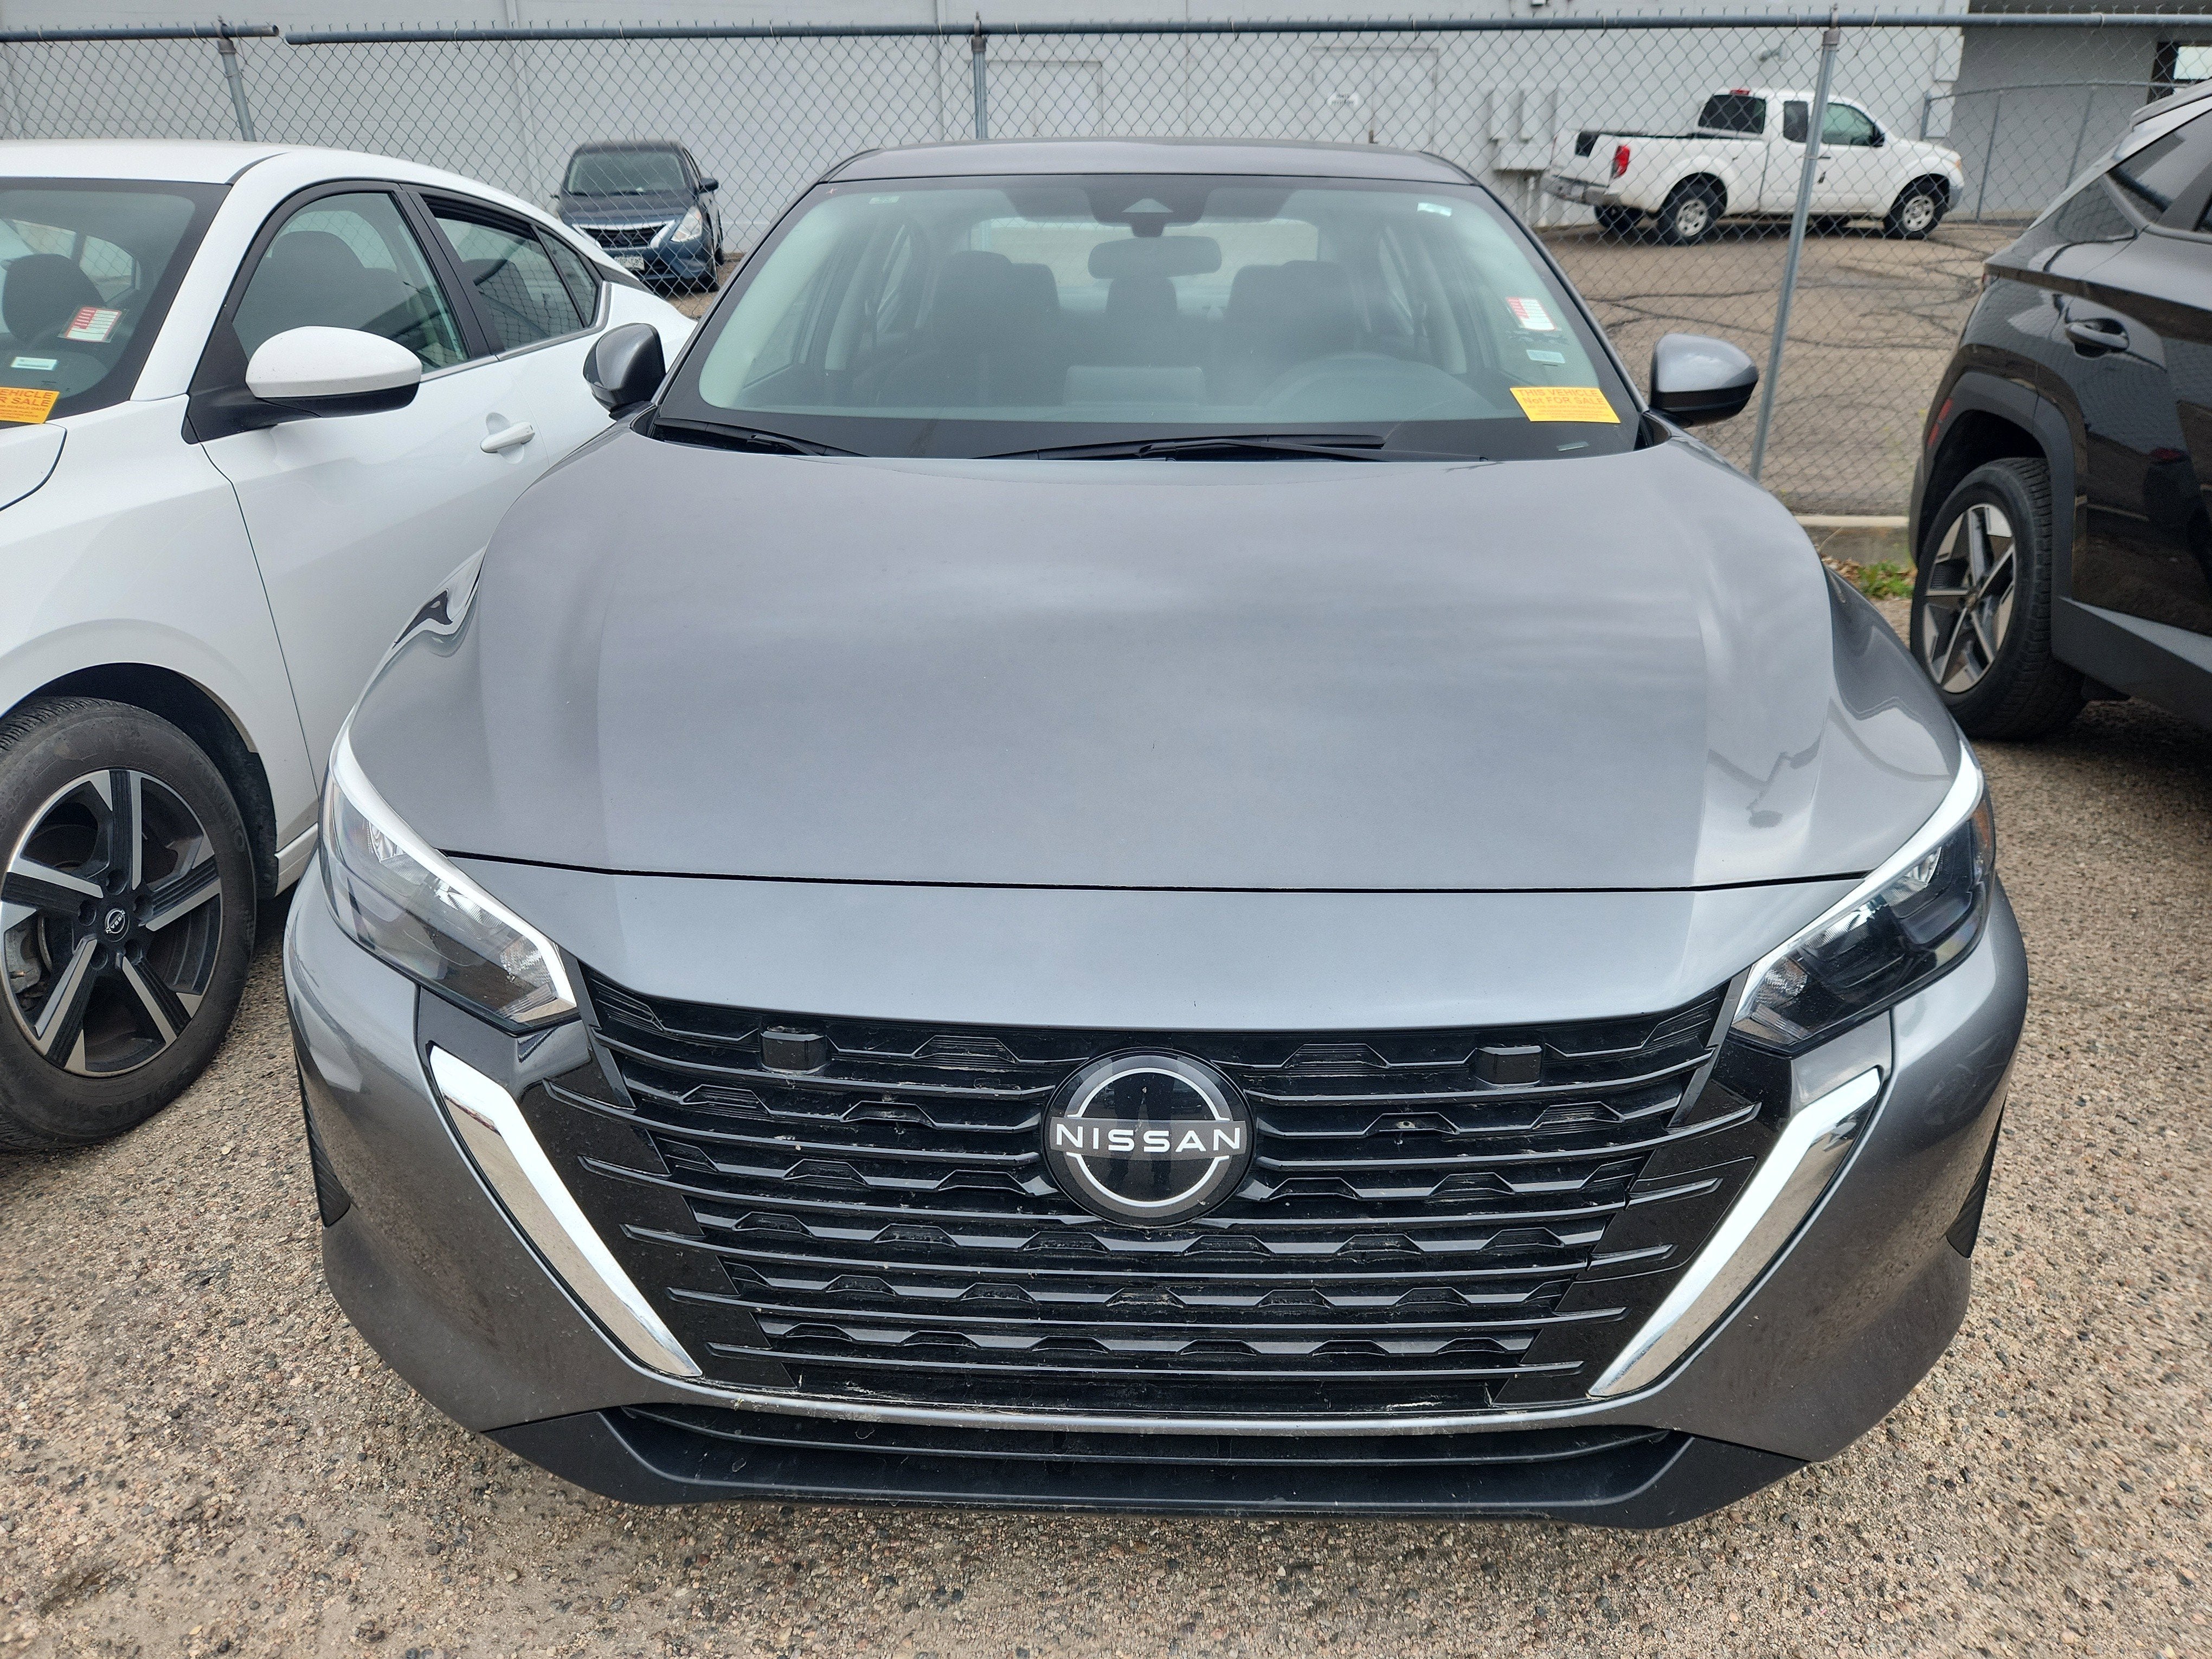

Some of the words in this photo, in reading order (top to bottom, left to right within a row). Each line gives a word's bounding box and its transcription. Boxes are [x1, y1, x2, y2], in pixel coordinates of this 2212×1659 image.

[0, 389, 53, 400] EHICLE
[11, 397, 51, 407] SALE
[1056, 1123, 1240, 1153] NISSAN
